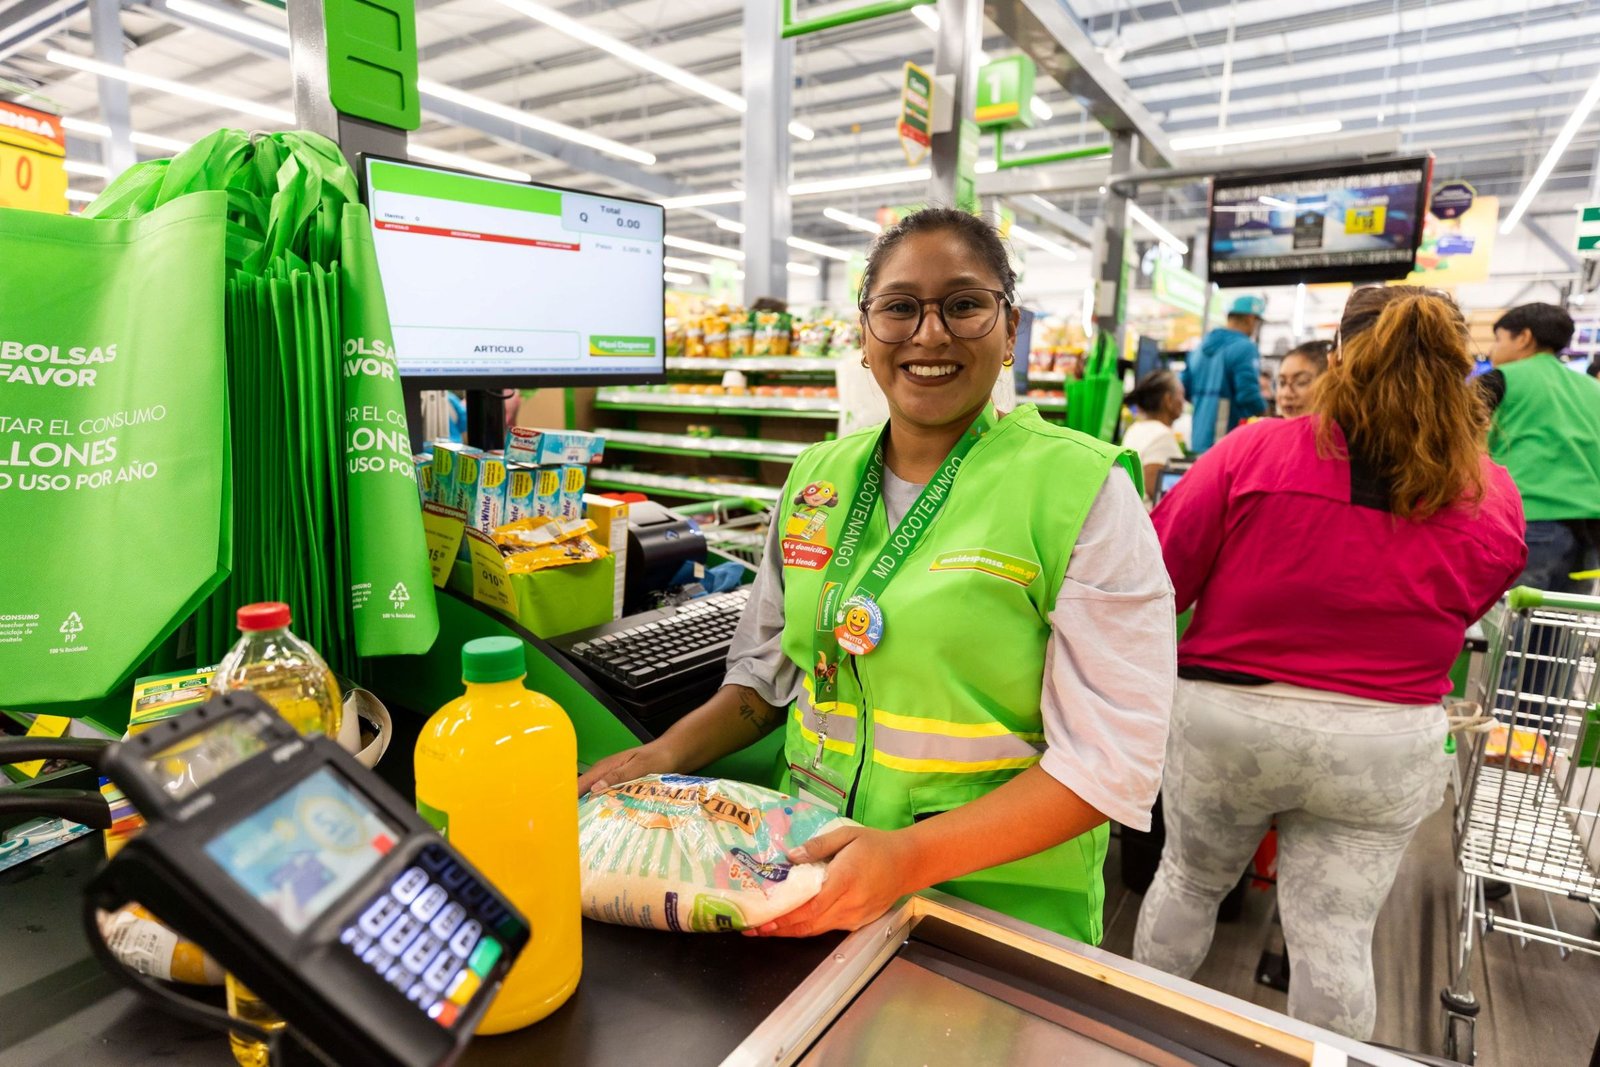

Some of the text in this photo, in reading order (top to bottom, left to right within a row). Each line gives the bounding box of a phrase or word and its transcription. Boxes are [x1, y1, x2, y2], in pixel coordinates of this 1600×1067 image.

[985, 71, 1002, 104] 1
[579, 212, 640, 230] Q 0.00
[600, 205, 621, 215] Total
[343, 337, 397, 365] OLSA
[474, 345, 524, 353] ARTICULO
[49, 419, 75, 436] EL
[79, 404, 167, 435] CONSUMO
[363, 406, 383, 422] EL
[386, 409, 408, 430] CO
[346, 427, 413, 463] LONE
[18, 474, 71, 491] USO
[75, 469, 112, 490] POR
[114, 460, 158, 484] AÑO
[349, 456, 385, 474] USO
[835, 465, 881, 567] JOCOTENANGO
[871, 456, 962, 579] MD JOCOTENANGO
[795, 543, 828, 555] domicilio
[796, 558, 817, 567] tienda
